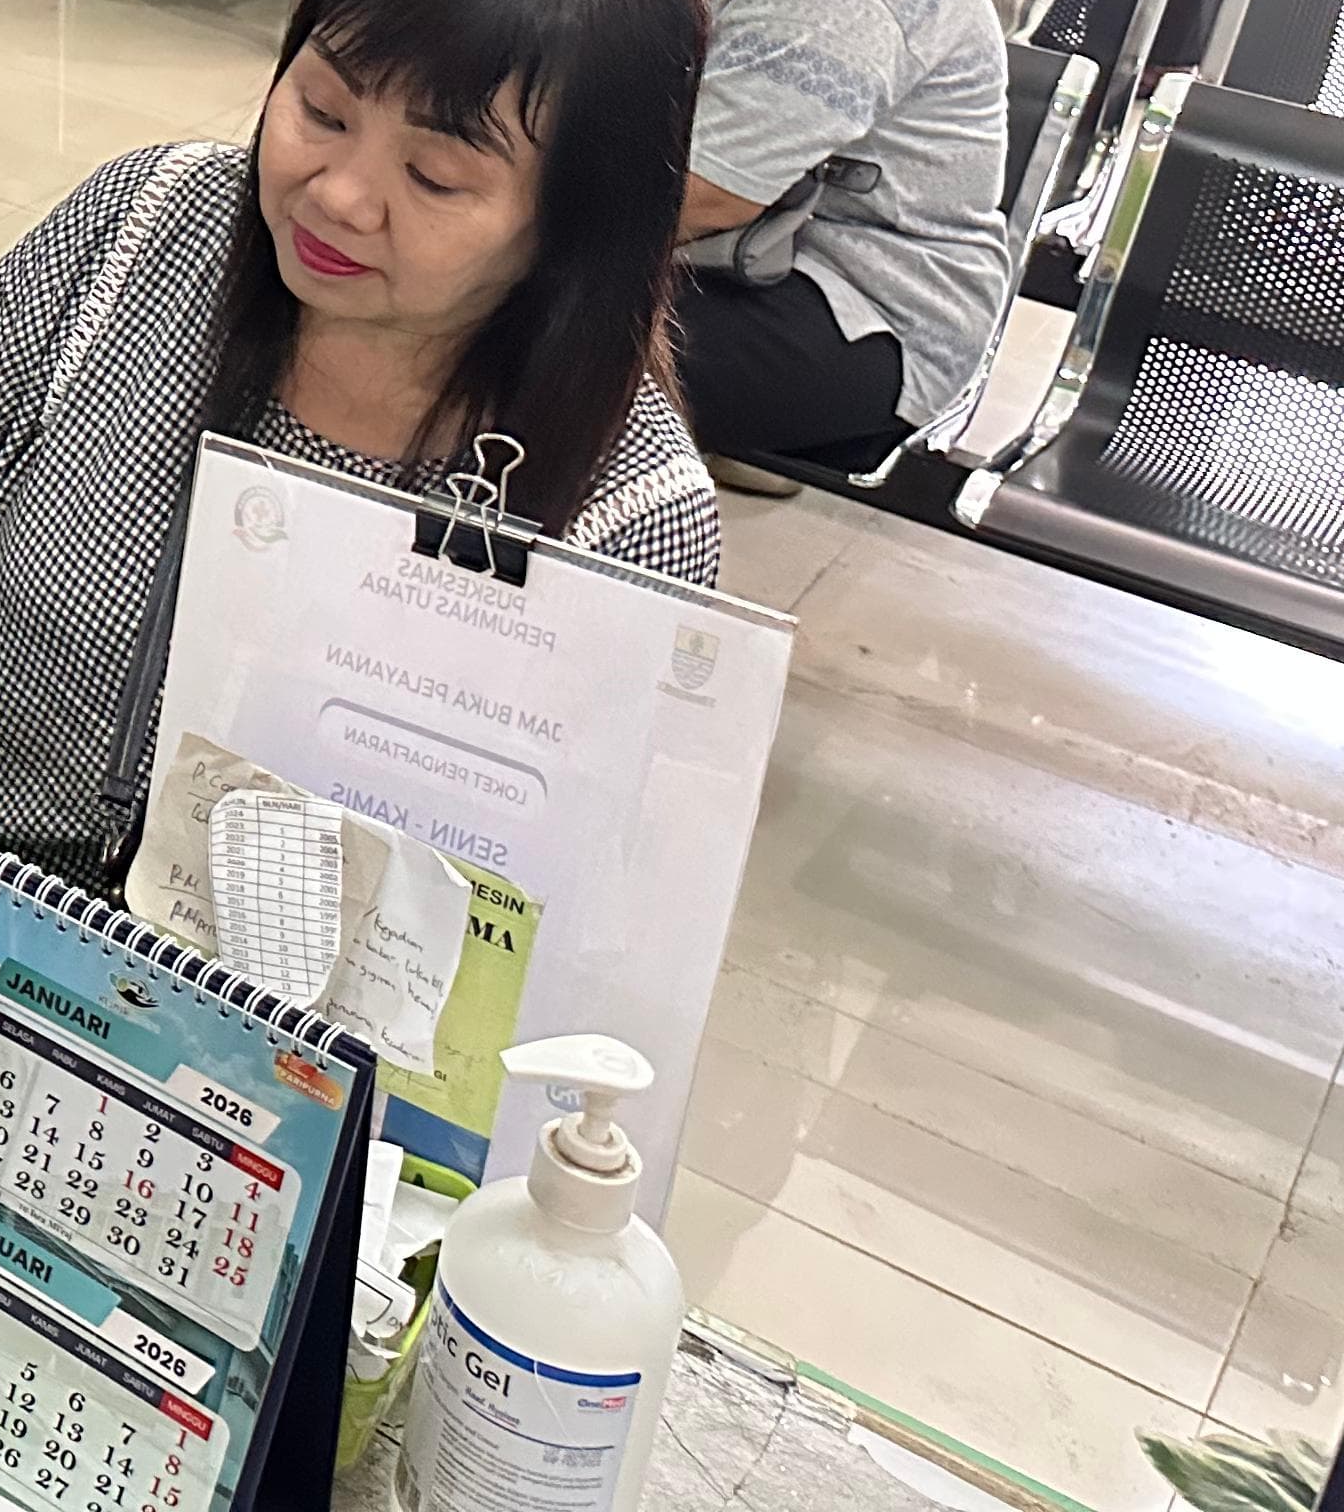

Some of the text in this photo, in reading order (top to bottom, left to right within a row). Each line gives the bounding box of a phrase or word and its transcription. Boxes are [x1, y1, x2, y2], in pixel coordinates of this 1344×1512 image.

[467, 914, 516, 953] MA
[6, 973, 112, 1039] JANUARI
[0, 1070, 16, 1090] 6
[45, 1093, 60, 1115] 7
[89, 1121, 104, 1141] 8
[137, 1149, 153, 1168] 9
[181, 1174, 213, 1203] 10
[230, 1202, 259, 1233] 11
[2, 1021, 34, 1045] SELASA
[51, 1049, 78, 1067] RABU
[96, 1074, 126, 1095] KAMIS
[142, 1100, 175, 1122] JUMAT
[192, 1127, 224, 1151] SABTU
[237, 1153, 277, 1182] MINGGU
[100, 1096, 261, 1201] 1 2 3 4
[200, 1086, 253, 1127] 2026
[30, 1117, 59, 1145] 14
[74, 1143, 106, 1171] 15
[122, 1170, 155, 1199] 16
[174, 1200, 207, 1230] 17
[223, 1228, 254, 1258] 18
[30, 1313, 60, 1337] KAMIS
[75, 1342, 108, 1367] JUMAT
[166, 1400, 208, 1432] MINGGU
[134, 1334, 186, 1378] 2026
[465, 1352, 511, 1398] Gel
[20, 1362, 38, 1382] 5
[68, 1392, 86, 1413] 6
[121, 1422, 136, 1445] 7
[165, 1454, 181, 1476] 8
